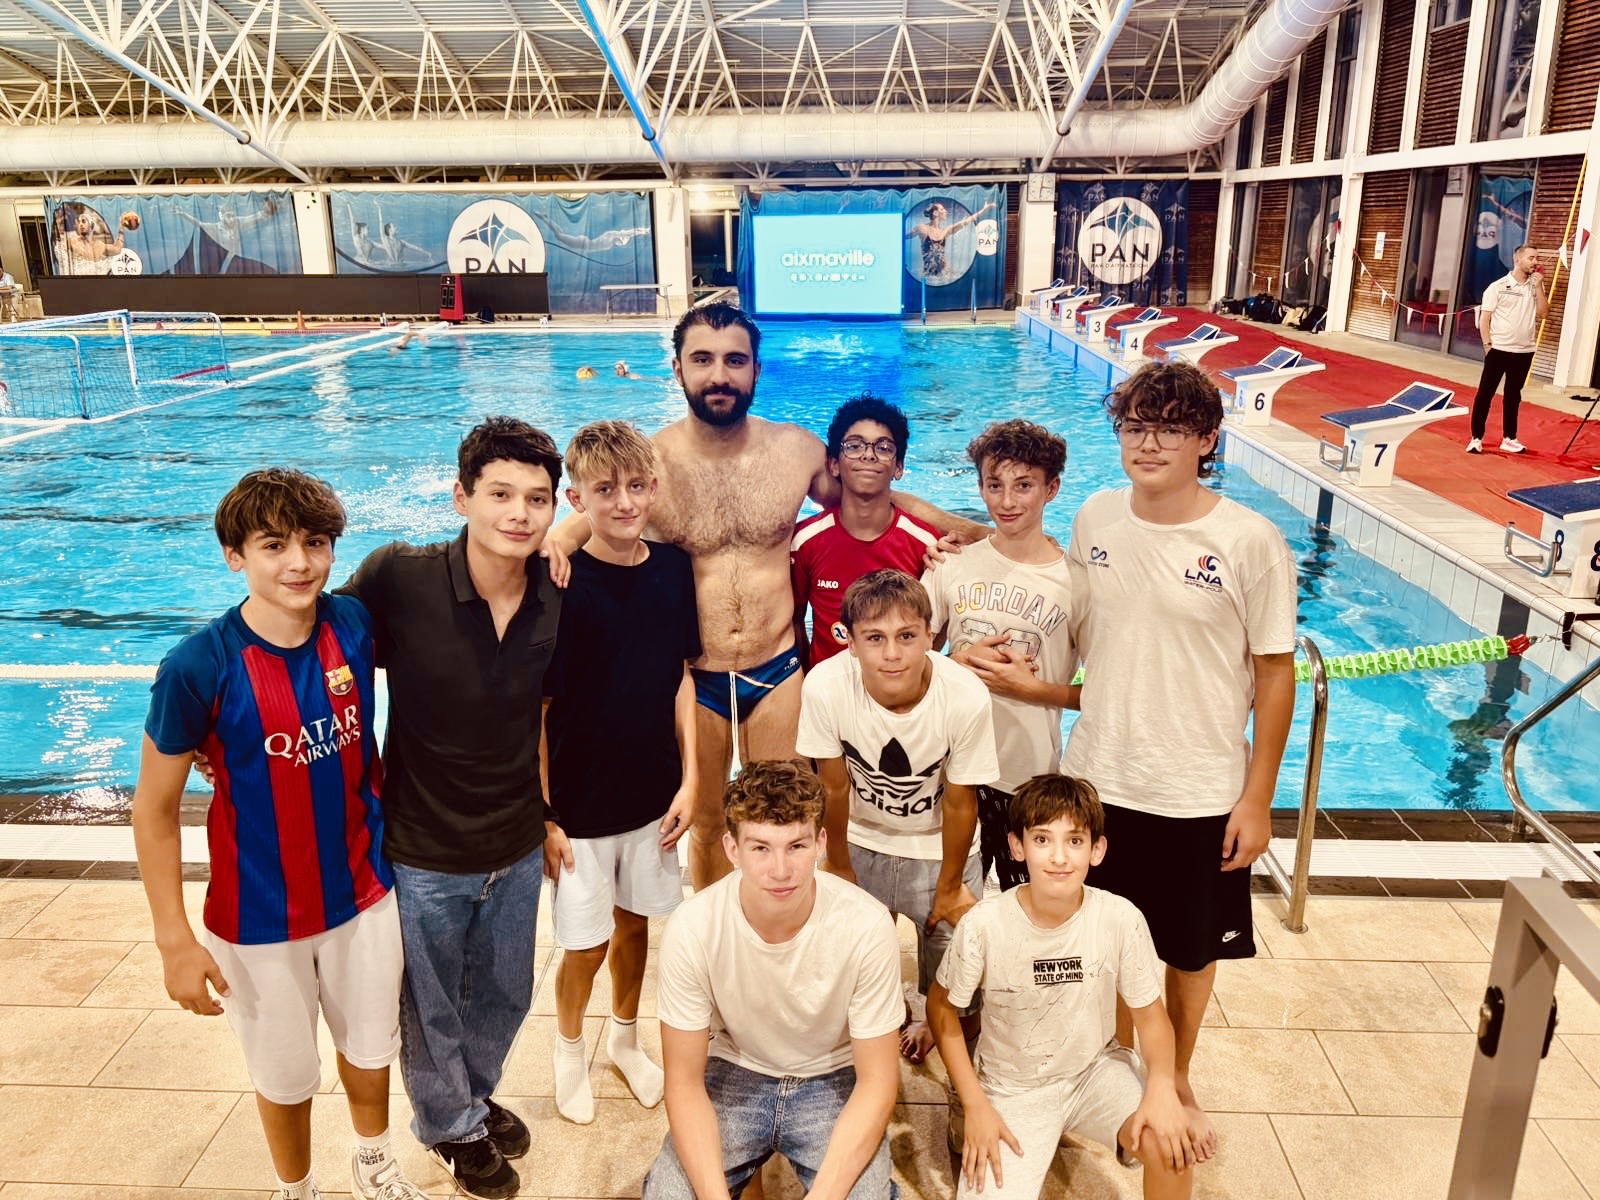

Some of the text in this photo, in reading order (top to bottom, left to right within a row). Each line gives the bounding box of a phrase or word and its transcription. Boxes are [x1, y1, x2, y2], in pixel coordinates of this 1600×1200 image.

[781, 248, 876, 268] aixmaville
[1091, 243, 1150, 262] PAN
[465, 257, 526, 274] PAN
[1045, 299, 1050, 309] 1
[1065, 308, 1073, 320] 2
[1094, 321, 1102, 333] 3
[1130, 337, 1139, 351] 4
[1254, 392, 1266, 411] 6
[1374, 443, 1389, 467] 7
[1554, 529, 1565, 563] 8
[817, 579, 839, 589] JAKO
[1184, 568, 1223, 587] LNA
[953, 581, 1068, 638] JORDAN
[264, 704, 359, 759] QATAR
[294, 726, 361, 768] AIRWAYS
[1033, 959, 1083, 974] NEW YORK
[1033, 971, 1084, 983] STATE OF MIND
